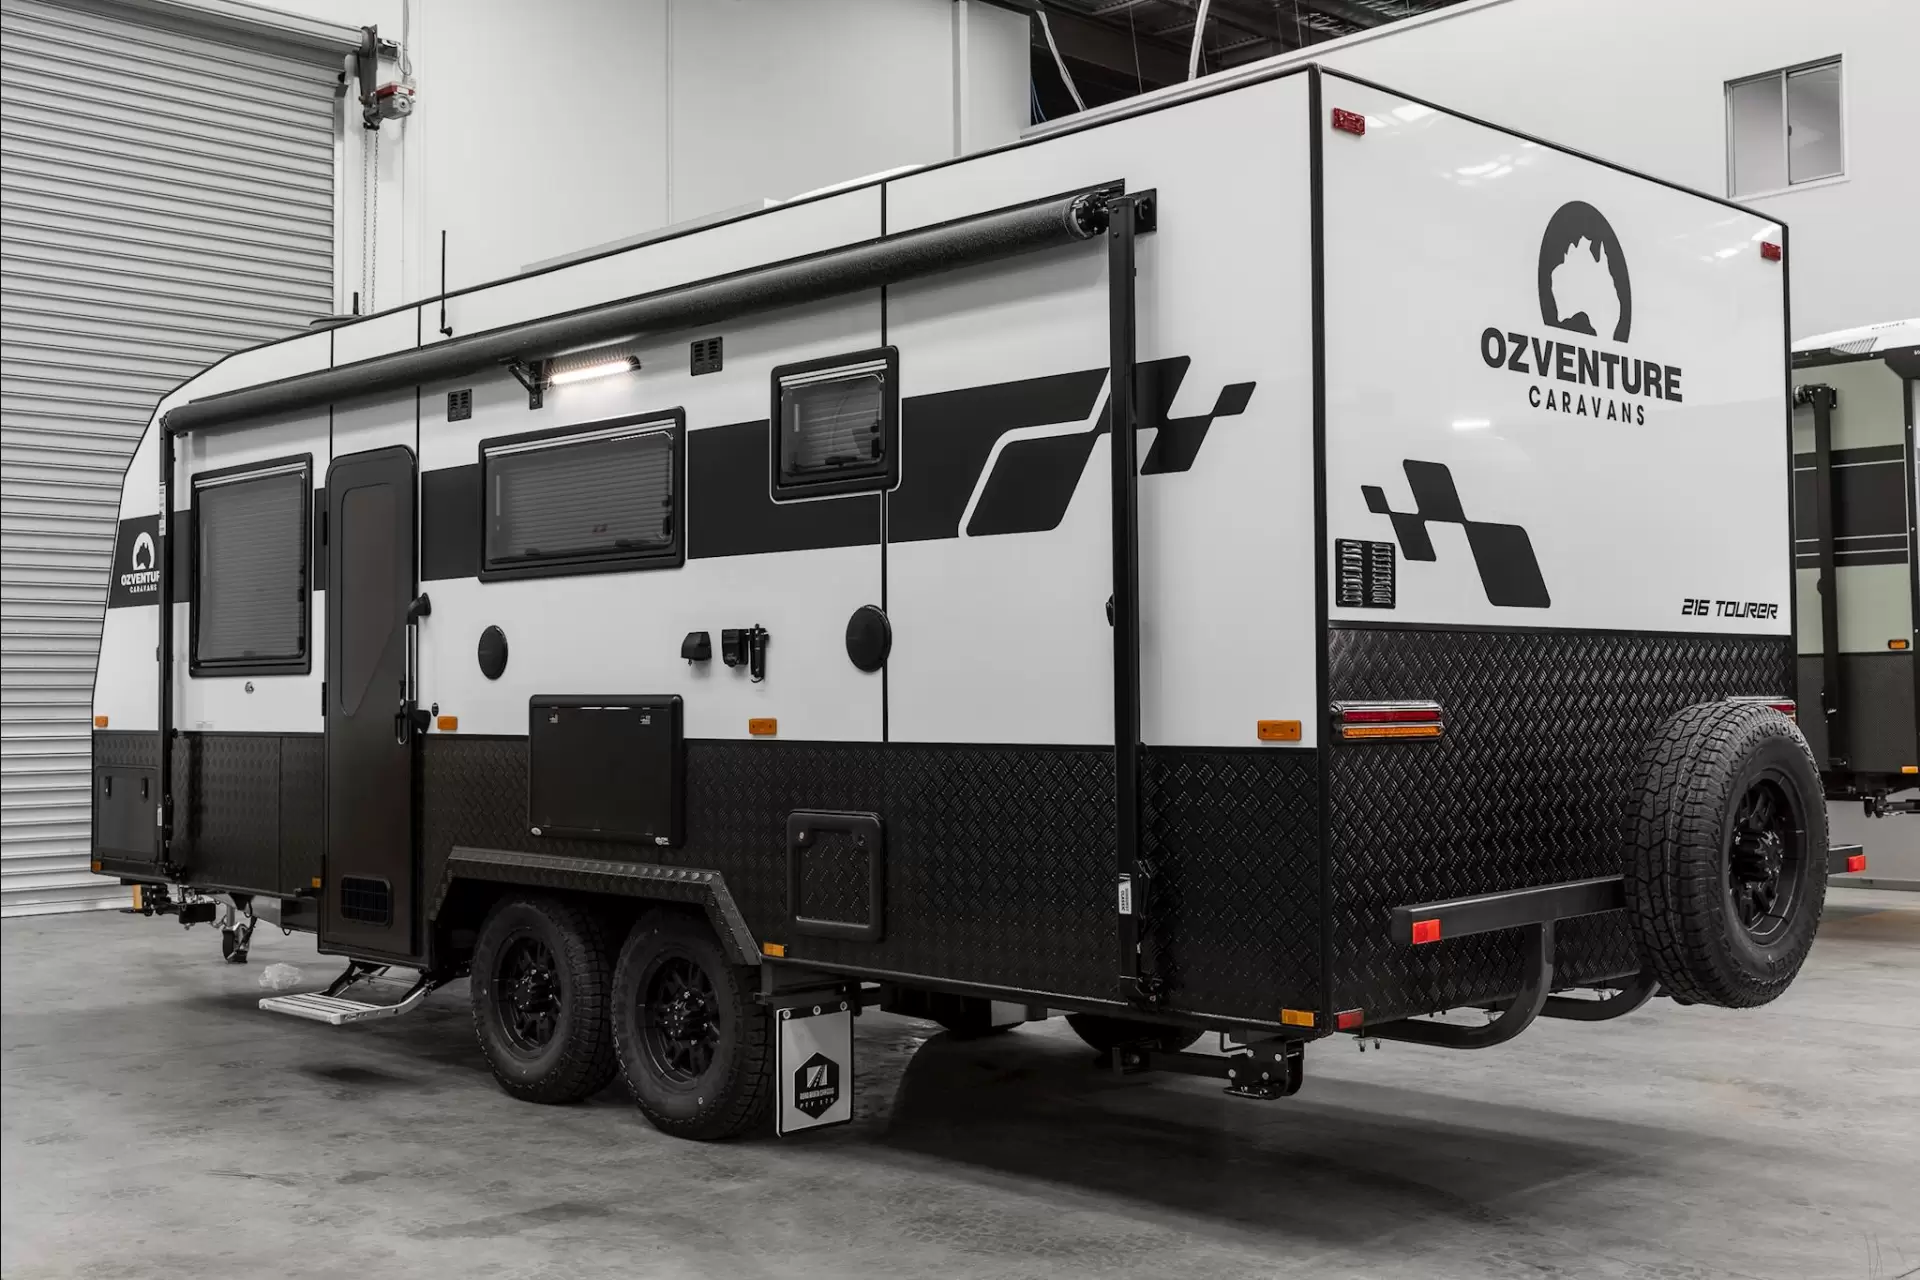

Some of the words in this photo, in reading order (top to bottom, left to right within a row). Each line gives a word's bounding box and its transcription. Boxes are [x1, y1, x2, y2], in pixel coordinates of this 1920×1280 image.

[1481, 327, 1683, 403] OZVENTURE
[1529, 385, 1645, 426] CARAVANS
[130, 584, 157, 593] CARAVANS
[1681, 598, 1711, 616] 216
[1715, 600, 1779, 620] TOURER
